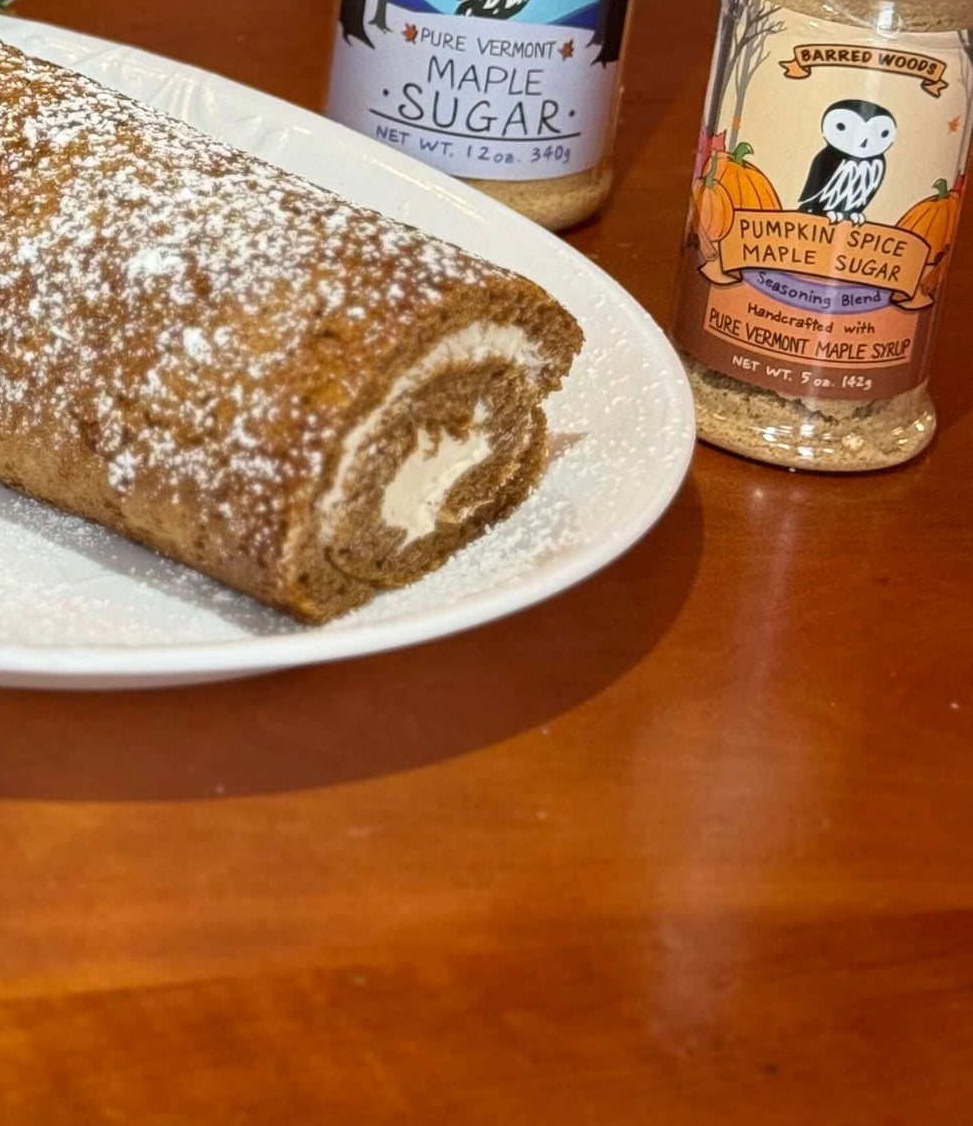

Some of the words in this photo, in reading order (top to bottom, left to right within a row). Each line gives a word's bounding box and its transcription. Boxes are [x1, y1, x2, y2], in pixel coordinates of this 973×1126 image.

[420, 27, 467, 52] PURE
[476, 37, 557, 60] VERMONT
[800, 48, 872, 63] BARRED
[878, 53, 937, 75] WOODS
[427, 55, 544, 96] MAPLE
[397, 82, 562, 137] SUGAR
[376, 124, 410, 145] NET
[419, 138, 454, 158] WT.
[530, 145, 571, 165] 340g
[739, 218, 836, 245] PUMPKIN
[846, 230, 908, 258] SPICE
[742, 243, 818, 265] MAPLE
[834, 254, 902, 282] SUGAR
[756, 271, 832, 310] Seasoning
[841, 290, 882, 307] Blend
[709, 307, 742, 336] PURE
[746, 322, 810, 355] VERMONT
[815, 340, 868, 360] MAPLE
[870, 338, 912, 360] SYRUP
[747, 302, 834, 334] Handcrafted
[844, 321, 876, 335] with
[732, 355, 760, 372] NET
[766, 365, 793, 382] WT.
[842, 375, 873, 390] 142g
